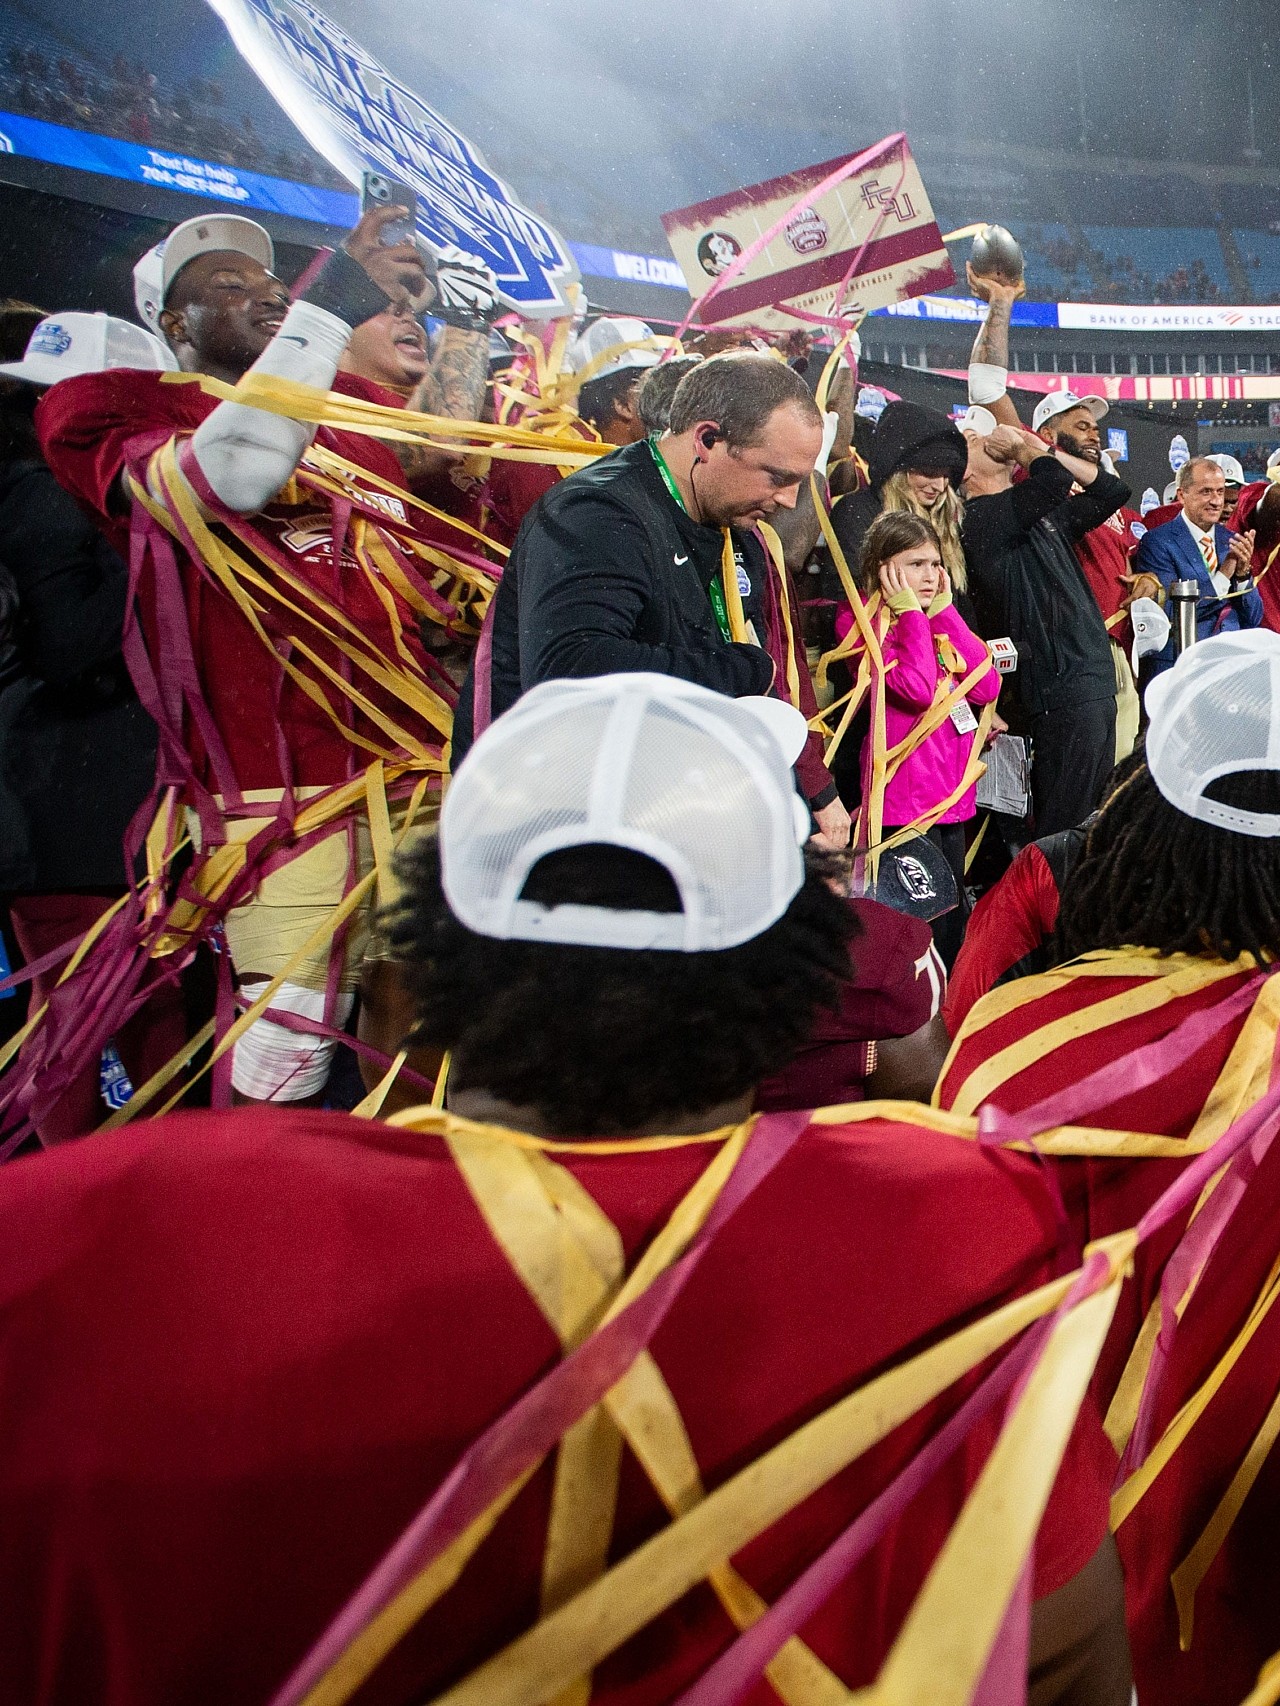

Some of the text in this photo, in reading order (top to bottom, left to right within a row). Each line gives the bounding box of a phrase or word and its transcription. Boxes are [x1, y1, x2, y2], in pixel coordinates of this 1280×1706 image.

[860, 180, 916, 222] FSU
[1090, 315, 1127, 325] BANK
[1131, 315, 1149, 325] OF
[1152, 315, 1214, 326] AMERICA
